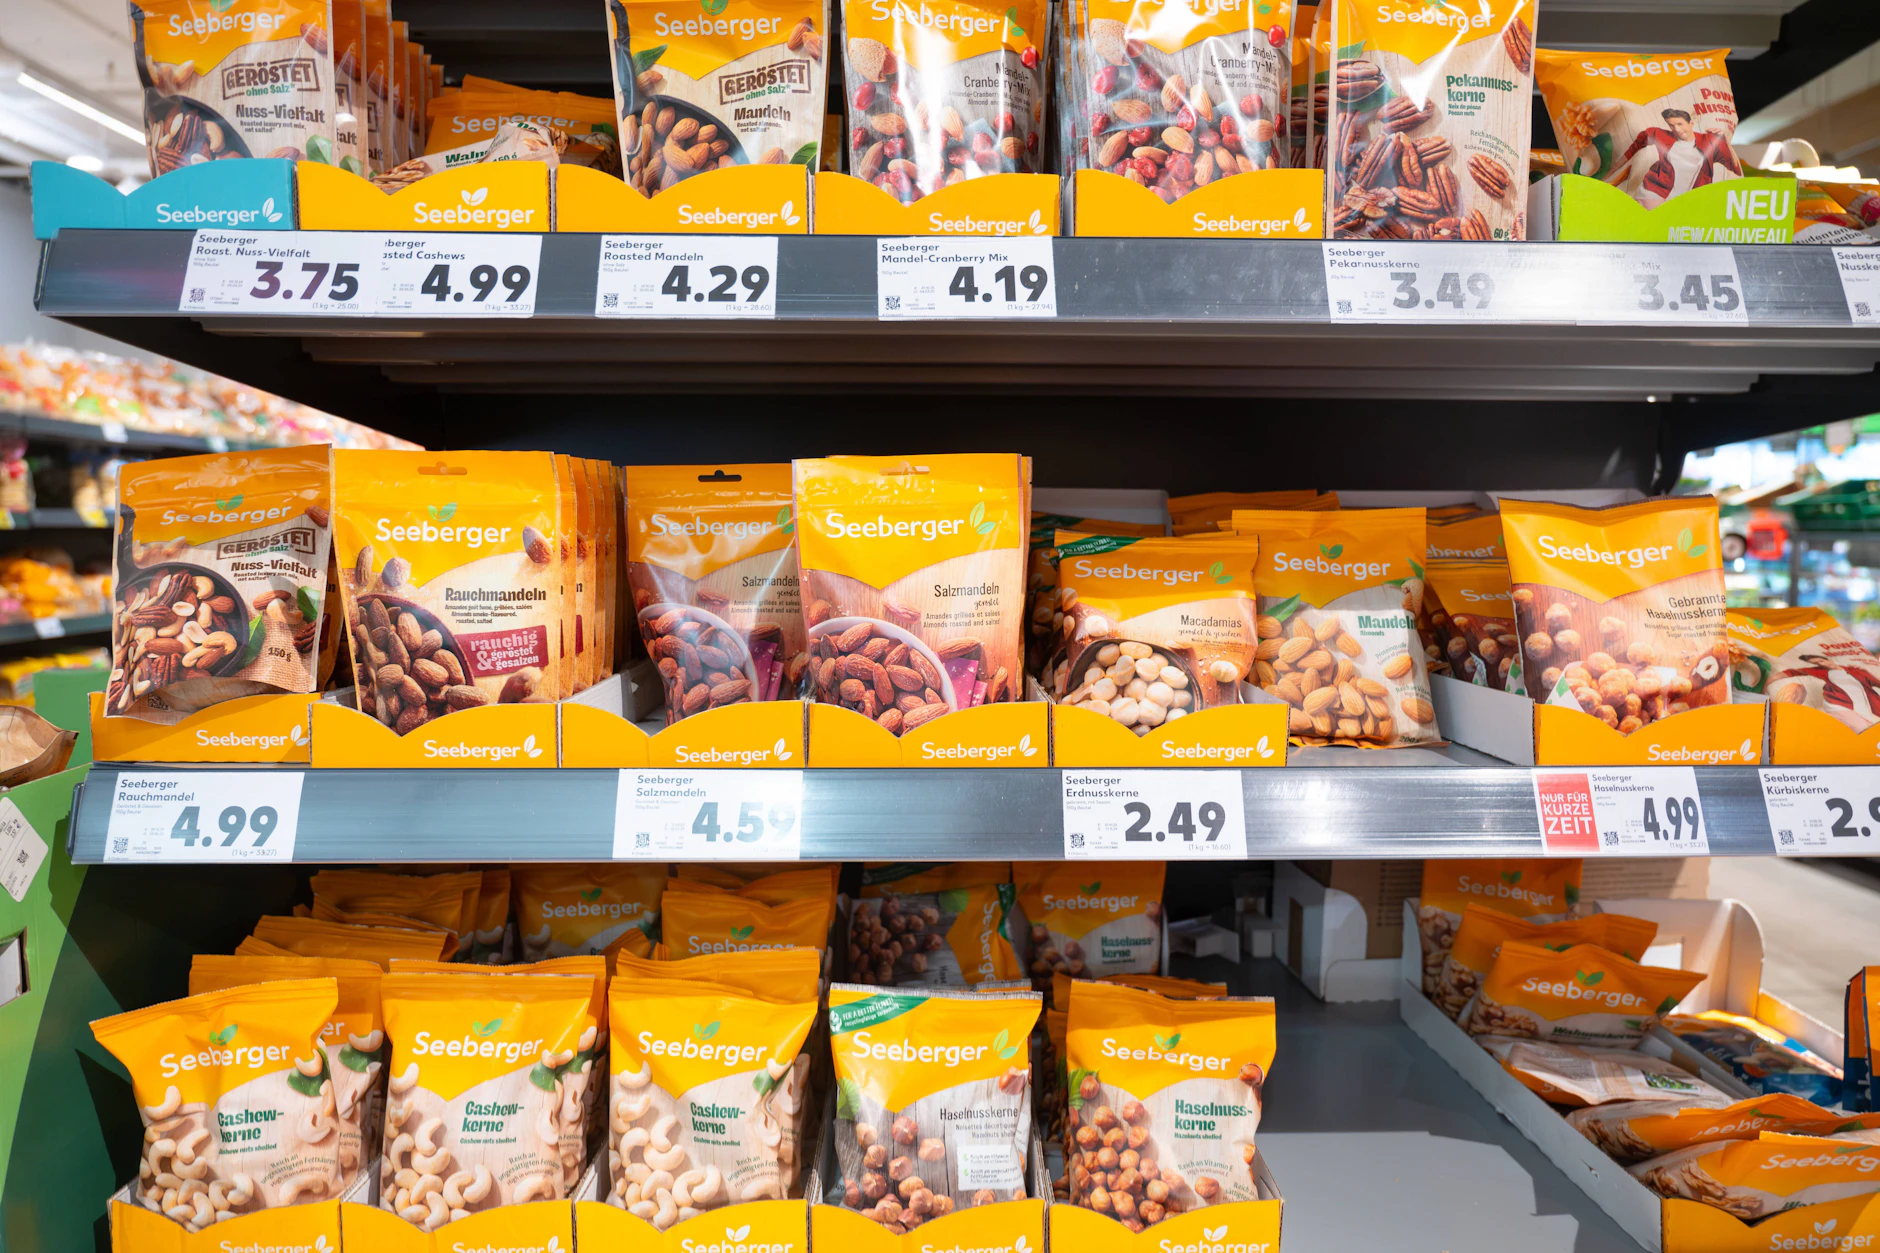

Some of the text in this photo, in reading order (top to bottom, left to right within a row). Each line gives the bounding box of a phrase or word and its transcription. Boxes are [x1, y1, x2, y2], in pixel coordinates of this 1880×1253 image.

[167, 11, 285, 37] Seeberger
[654, 12, 782, 41] Seeberger
[1377, 6, 1495, 34] Seeberger
[226, 61, 313, 89] GERÖSTET
[1581, 56, 1713, 78] Seeberger
[724, 64, 806, 96] GERÖSTET
[1446, 74, 1518, 92] Pekannuss-
[246, 86, 269, 97] ohne
[745, 89, 766, 100] ohne
[1447, 89, 1486, 103] kerne
[236, 104, 325, 123] Nuss-Vielfalt
[734, 104, 791, 122] Mandeln
[156, 203, 259, 226] Seeberger
[1725, 190, 1789, 221] NEU
[413, 202, 535, 229] Seeberger
[678, 204, 778, 229] Seeberger
[929, 212, 1025, 236] Seeberger
[1193, 212, 1290, 236] Seeberger
[199, 234, 258, 246] Seeberger
[1668, 226, 1787, 244] NEW/NOUVEAU
[196, 246, 311, 258] Roast. Nuss-Vielfalt
[605, 240, 663, 250] Seeberger
[882, 243, 940, 253] Seeberger
[1329, 248, 1385, 257] Seeberger
[416, 250, 466, 261] Cashews
[604, 252, 704, 261] Roasted Mandeln
[882, 253, 1009, 264] Mandel-Cranberry Mix
[1330, 259, 1420, 269] Pekannusskerne
[249, 260, 360, 302] 3.75
[420, 263, 531, 303] 4.99
[661, 265, 770, 303] 4.29
[949, 265, 1048, 303] 4.19
[1390, 272, 1496, 310] 3.49
[1633, 274, 1740, 311] 3.45
[319, 302, 359, 311] kg 25.00)
[491, 303, 531, 312] kg 33.27)
[732, 304, 772, 312] kg 28.60)
[1014, 303, 1053, 311] kg 27.94)
[160, 504, 292, 526] Seeberger
[376, 518, 512, 548] Seeberger
[651, 513, 773, 541] Seeberger
[826, 513, 965, 541] Seeberger
[223, 531, 311, 555] GERÖSTET
[1538, 535, 1672, 568] Seeberger
[231, 559, 318, 579] Nuss-Vielfalt
[1074, 560, 1205, 586] Seeberger
[1274, 552, 1391, 581] Seeberger
[742, 575, 800, 588] Salzmandeln
[934, 583, 1000, 598] Salzmandeln
[445, 587, 547, 602] Rauchmandeln
[1180, 614, 1242, 628] Macadamias
[470, 630, 538, 651] rauchig
[268, 648, 286, 658] 150
[476, 645, 534, 671] & geröstet
[495, 655, 540, 671] gesalzen
[196, 729, 288, 750] Seeberger
[423, 739, 521, 761] Seeberger
[675, 745, 771, 765] Seeberger
[922, 742, 1016, 762] Seeberger
[1162, 740, 1254, 762] Seeberger
[1648, 744, 1737, 764] Seeberger
[120, 779, 179, 791] Seeberger
[637, 775, 694, 785] Seeberger
[1066, 776, 1121, 786] Seeberger
[1592, 774, 1632, 783] Seeberger
[1764, 774, 1817, 784] Seeberger
[118, 791, 195, 801] Rauchmandel
[636, 788, 707, 797] Salzmandeln
[1066, 789, 1139, 798] Erdnusskerne
[1541, 791, 1588, 803] NUR FÜR
[1594, 784, 1655, 792] Haselnusskerne
[1767, 786, 1830, 795] Kürbiskerne
[1544, 803, 1590, 816] KURZE
[170, 805, 279, 847] 4.99
[692, 801, 796, 843] 4.59
[1123, 801, 1226, 842] 2.49
[1545, 816, 1593, 835] ZEIT
[1643, 797, 1699, 841] 4.99
[238, 849, 248, 857] kg
[1195, 843, 1231, 851] kg 16.60)
[1457, 875, 1555, 907] Seeberger
[542, 901, 641, 919] Seeberger
[1044, 895, 1138, 912] Seeberger
[1101, 947, 1131, 958] kerne
[1522, 977, 1647, 1008] Seeberger
[412, 1032, 543, 1064] Seeberger
[638, 1031, 767, 1067] Seeberger
[852, 1031, 988, 1067] Seeberger
[1101, 1038, 1231, 1072] Seeberger
[159, 1045, 290, 1078] Seeberger
[465, 1101, 525, 1117] Cashew-
[690, 1102, 746, 1119] Cashew-
[940, 1105, 1018, 1120] Haselnusskerne
[1175, 1099, 1253, 1116] Haselnuss-
[217, 1109, 285, 1127] Cashew-
[462, 1117, 504, 1133] kerne
[692, 1118, 726, 1135] kerne
[1174, 1115, 1216, 1131] kerne
[220, 1127, 262, 1143] kerne
[254, 1143, 277, 1152] shelled
[1770, 1232, 1875, 1252] Seeberger
